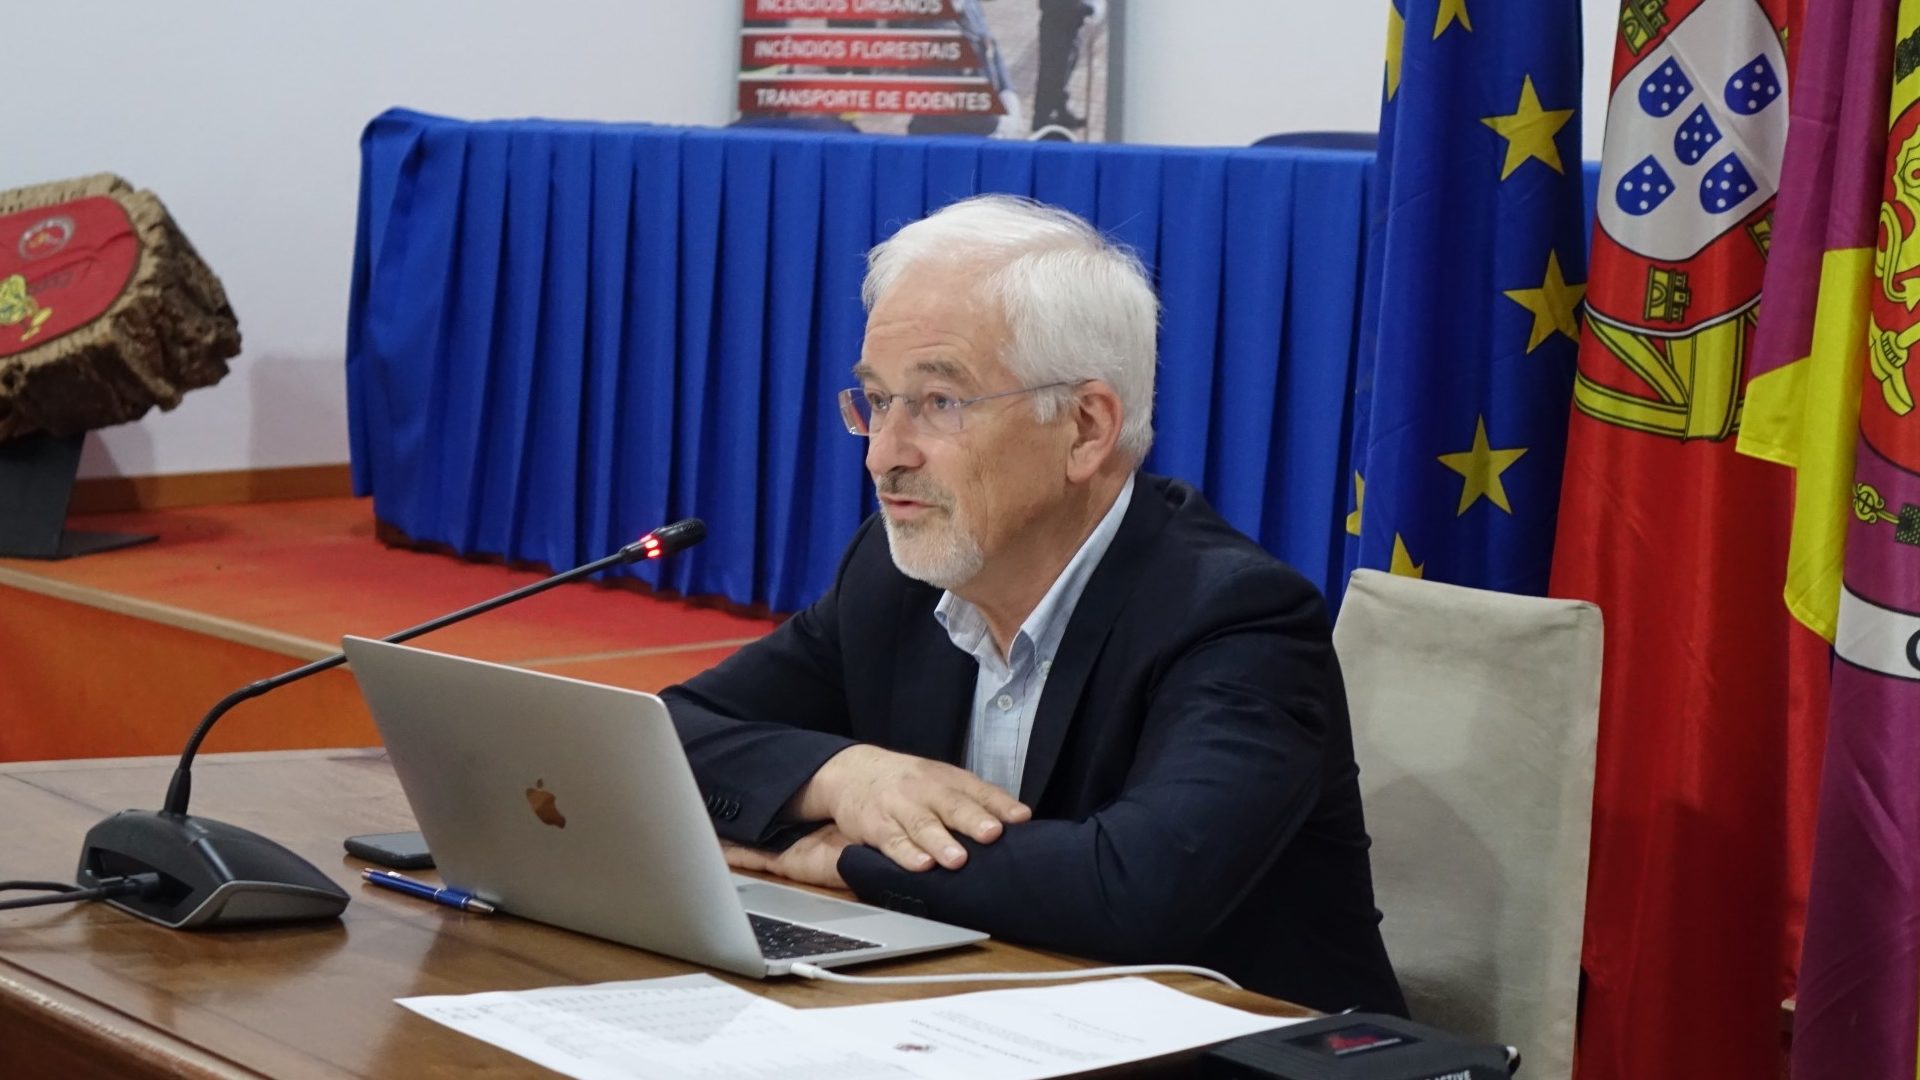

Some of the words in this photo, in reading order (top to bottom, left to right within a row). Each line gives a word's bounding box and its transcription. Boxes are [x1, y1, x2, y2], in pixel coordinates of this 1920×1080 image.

[755, 36, 846, 58] INCÊNDIOS
[850, 40, 961, 60] FLORESTAIS
[755, 88, 870, 108] TRANSPORTE
[875, 90, 901, 109] DE
[906, 92, 991, 111] DOENTES
